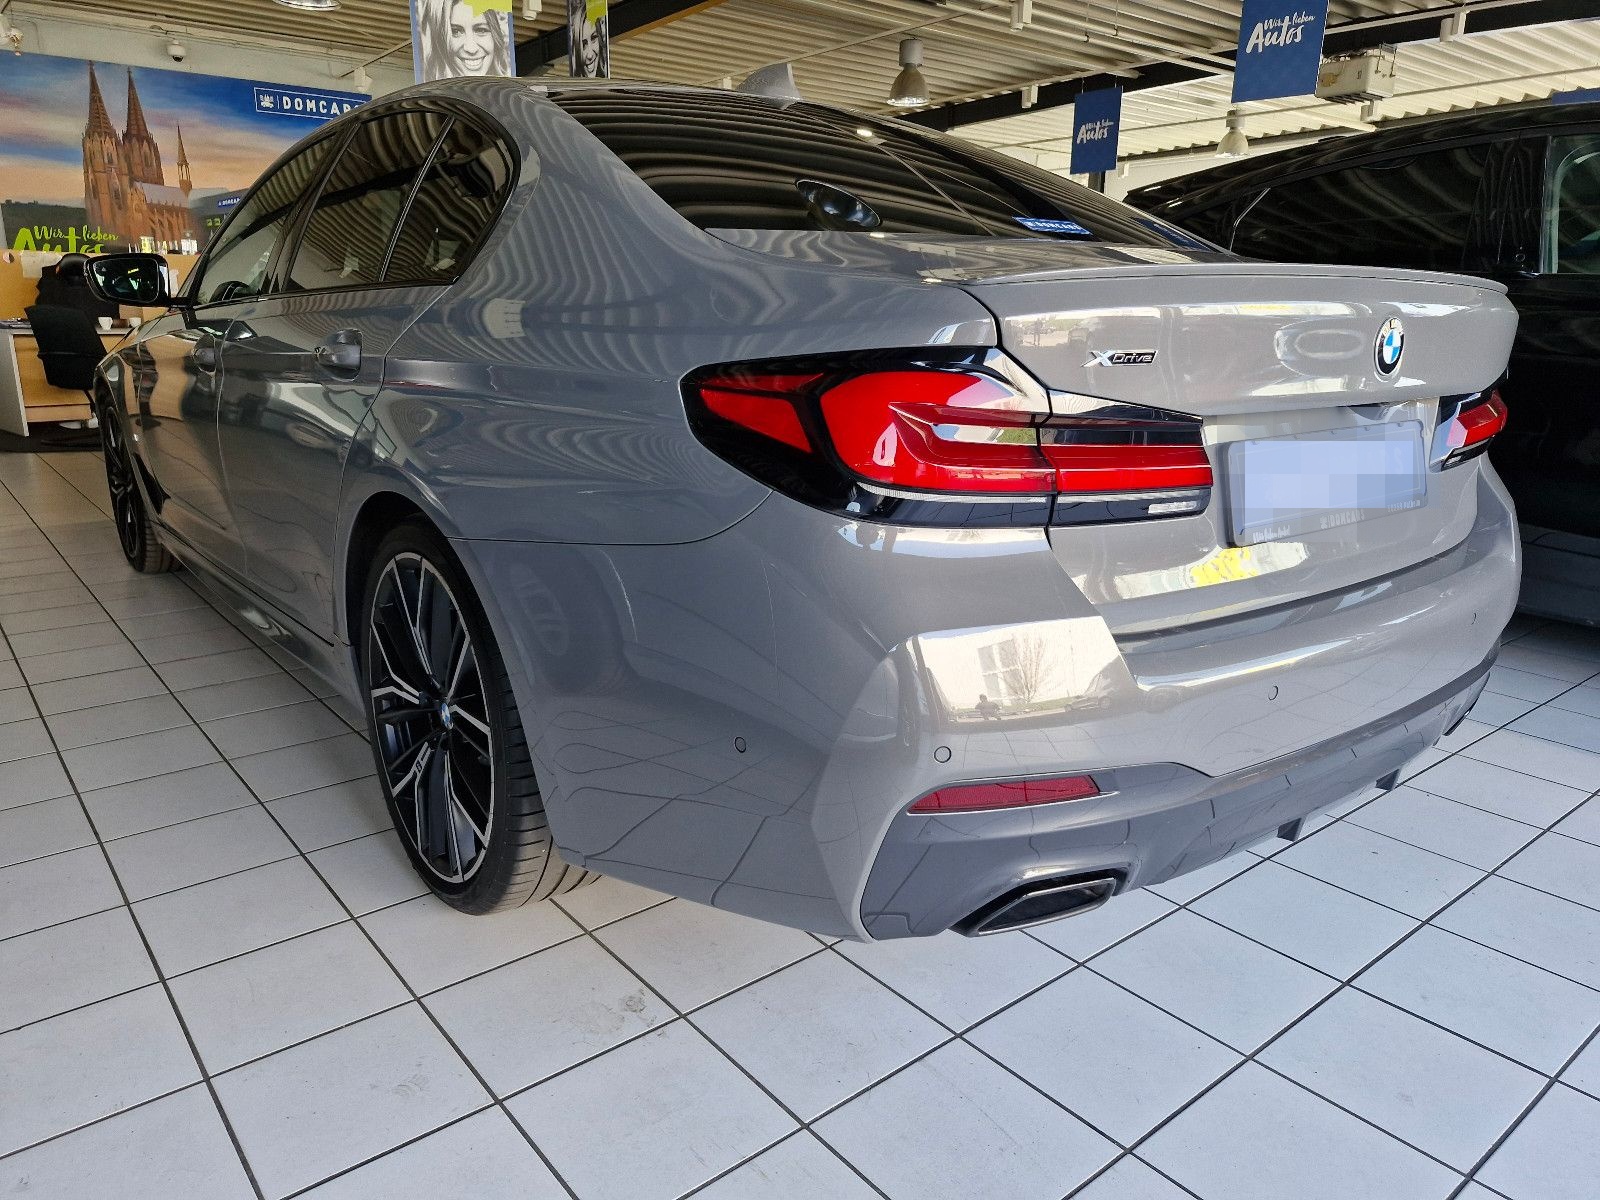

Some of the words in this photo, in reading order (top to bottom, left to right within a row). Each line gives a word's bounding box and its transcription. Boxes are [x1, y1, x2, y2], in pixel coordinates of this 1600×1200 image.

[1264, 18, 1282, 31] Wir
[1292, 11, 1315, 25] lieben
[1245, 16, 1304, 53] Autos
[282, 95, 359, 115] DOMCAR
[1076, 120, 1108, 144] Autos
[33, 225, 65, 240] Wir
[82, 225, 119, 242] lieben
